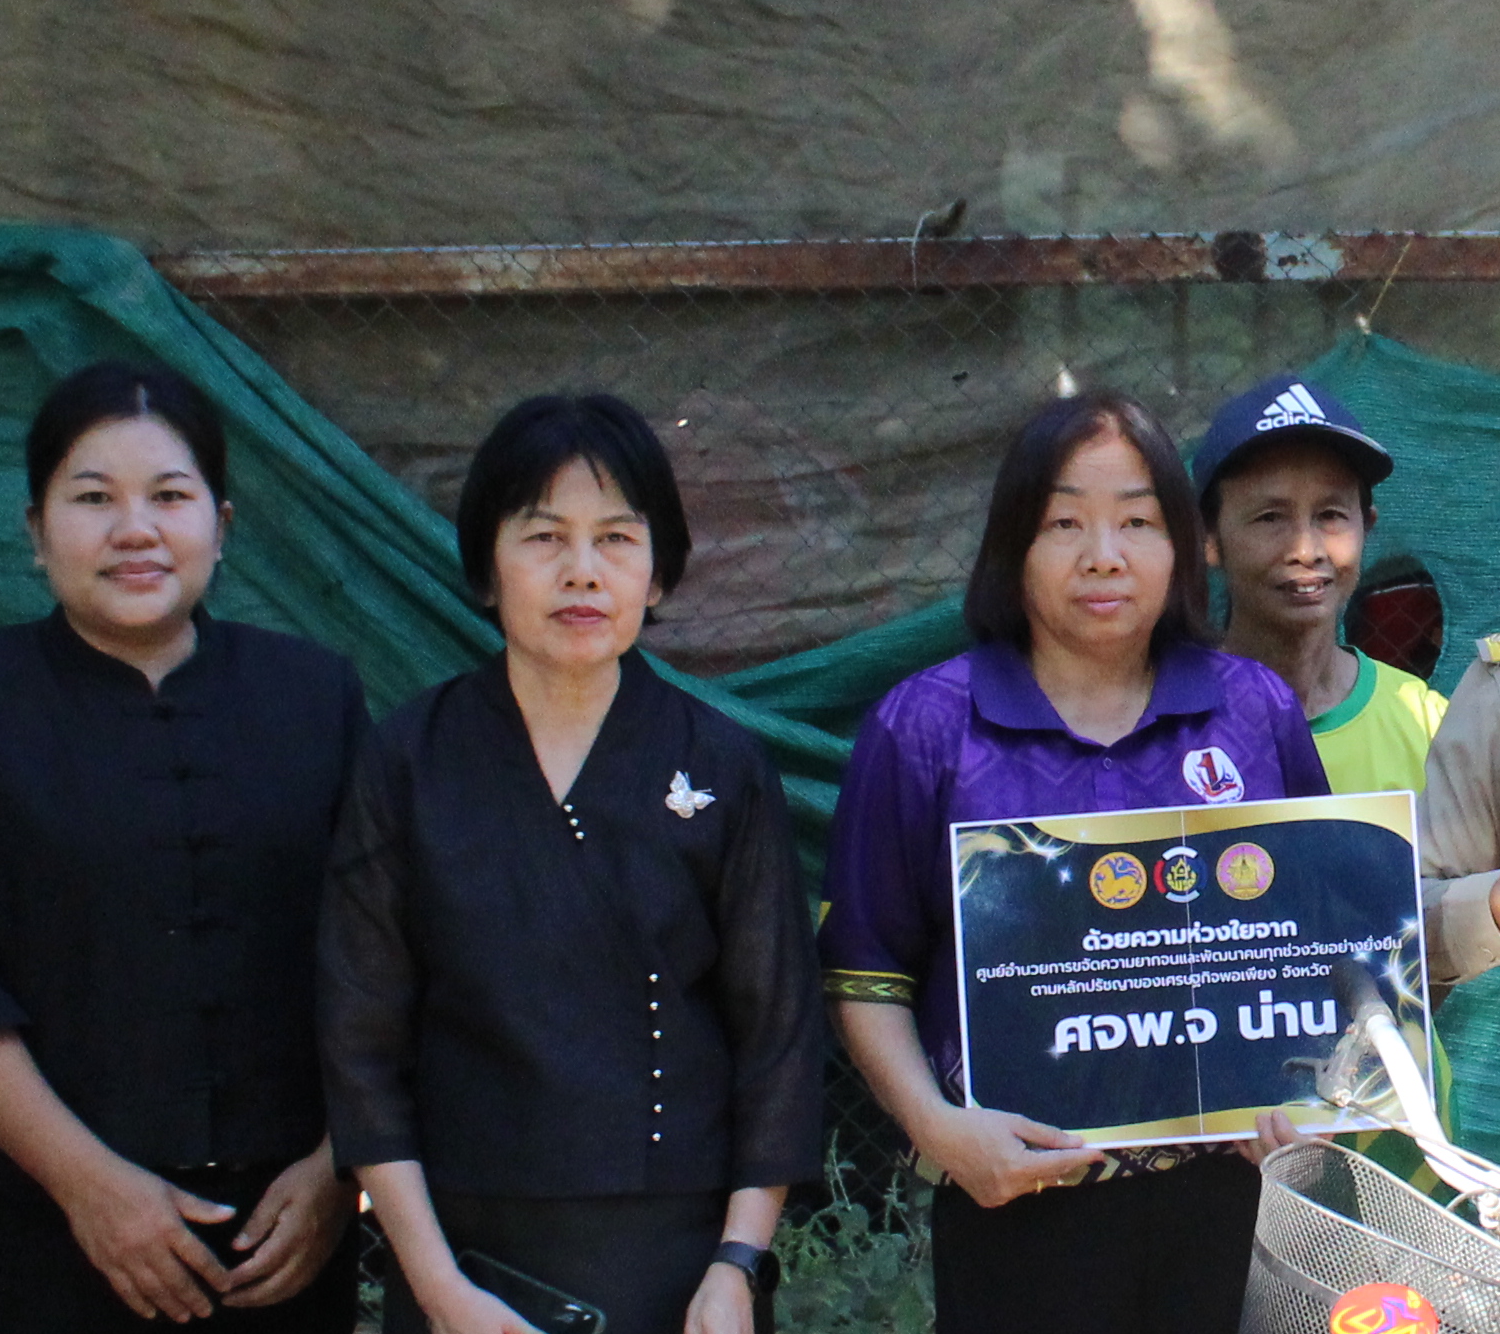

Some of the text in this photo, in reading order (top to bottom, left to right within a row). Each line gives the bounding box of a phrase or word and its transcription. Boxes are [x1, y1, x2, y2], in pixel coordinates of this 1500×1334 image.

[1256, 411, 1333, 432] adid
[1082, 919, 1298, 952] ด้วยความห่วงใยจาก
[1030, 965, 1278, 997] ตามหลักปรัชญาของเศรษฐกิจพอเพียง
[1054, 989, 1338, 1053] ศจพ.จ น่าน
